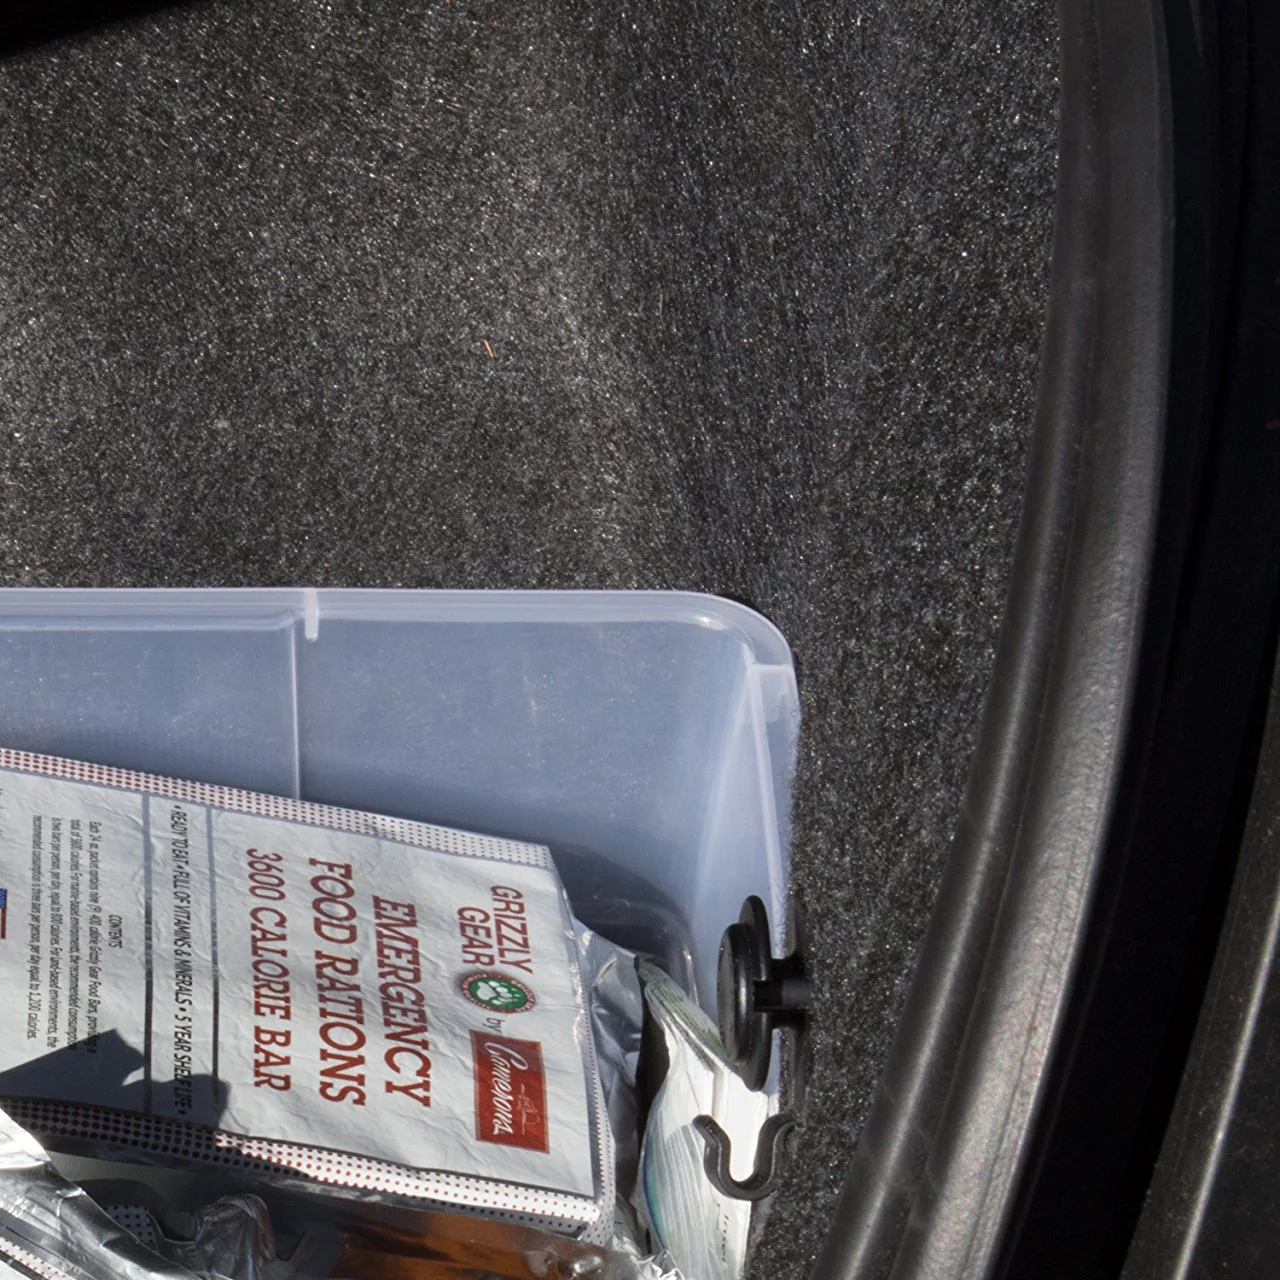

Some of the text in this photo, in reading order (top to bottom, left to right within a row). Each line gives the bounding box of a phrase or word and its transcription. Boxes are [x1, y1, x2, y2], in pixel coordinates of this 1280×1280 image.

[107, 913, 123, 949] CONTENTS
[169, 809, 193, 1110] READY TO EAT FULL OF VITAMINS & MINERALS 5 YEAR SHELF LIFE
[245, 847, 292, 1091] 3600 CALORIE BAR
[307, 857, 366, 1106] FOOD RATIONS
[371, 894, 432, 1108] EMERGENCY
[456, 905, 495, 966] GEAR
[489, 884, 533, 974] GRIZZLY
[482, 1017, 506, 1034] by
